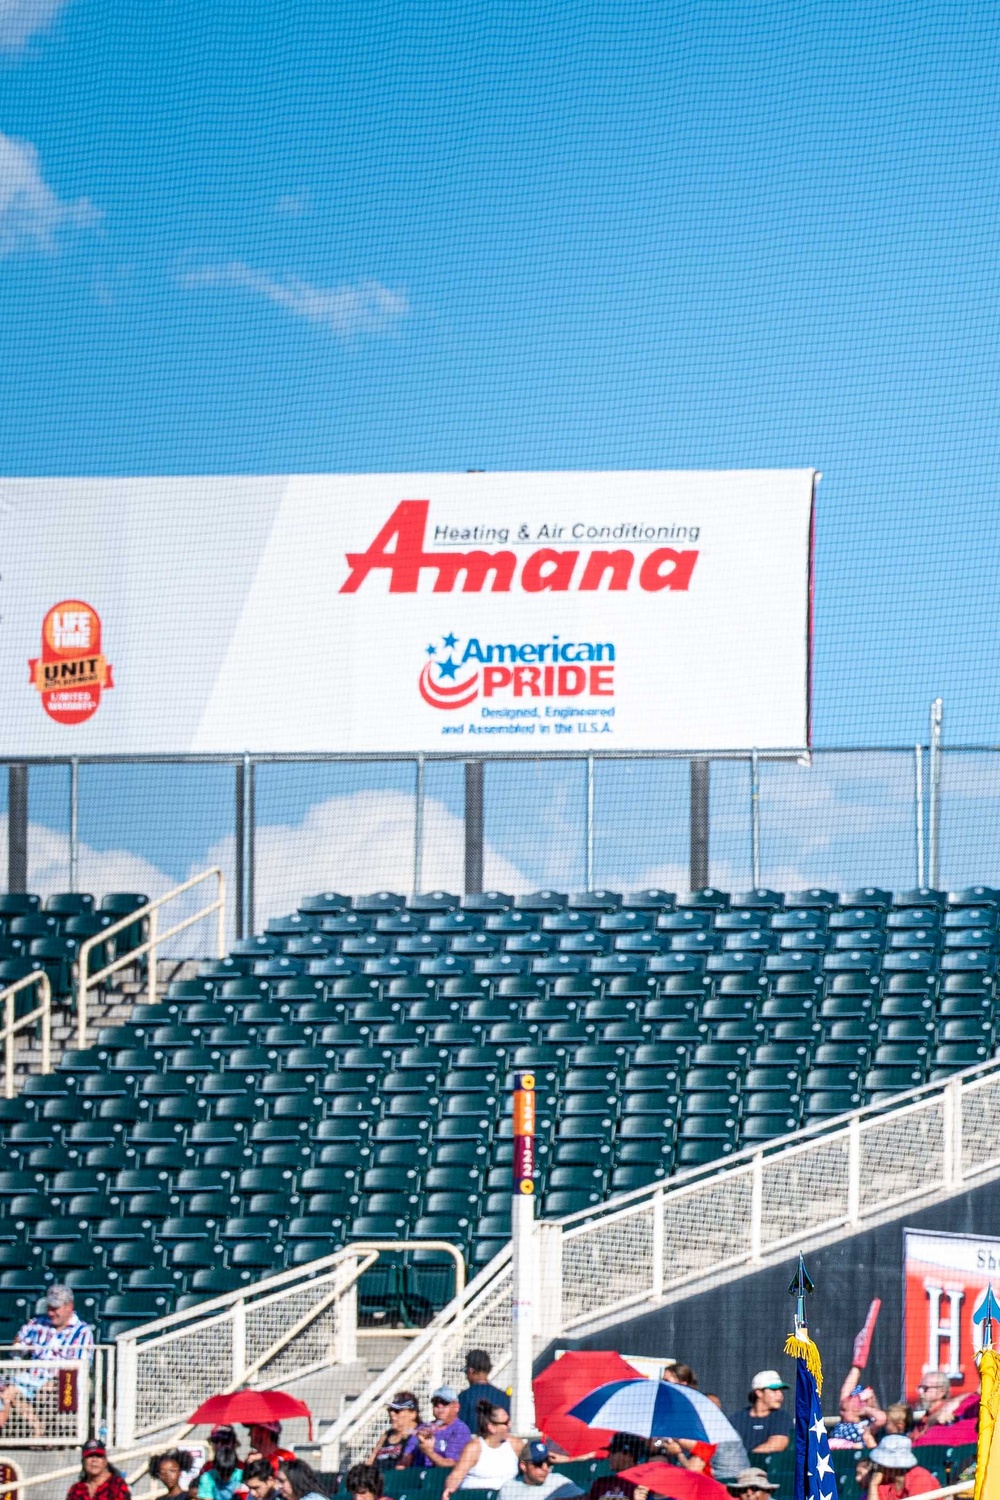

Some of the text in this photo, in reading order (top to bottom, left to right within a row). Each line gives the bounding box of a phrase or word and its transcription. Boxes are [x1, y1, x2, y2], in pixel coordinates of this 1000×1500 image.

[433, 522, 701, 542] Heating & Air Conditioning
[338, 500, 699, 594] Amana
[461, 635, 616, 663] American
[44, 659, 99, 681] UNIT
[483, 665, 615, 697] PRIDE
[481, 706, 616, 719] Designed, Engineered
[522, 1136, 533, 1177] 122
